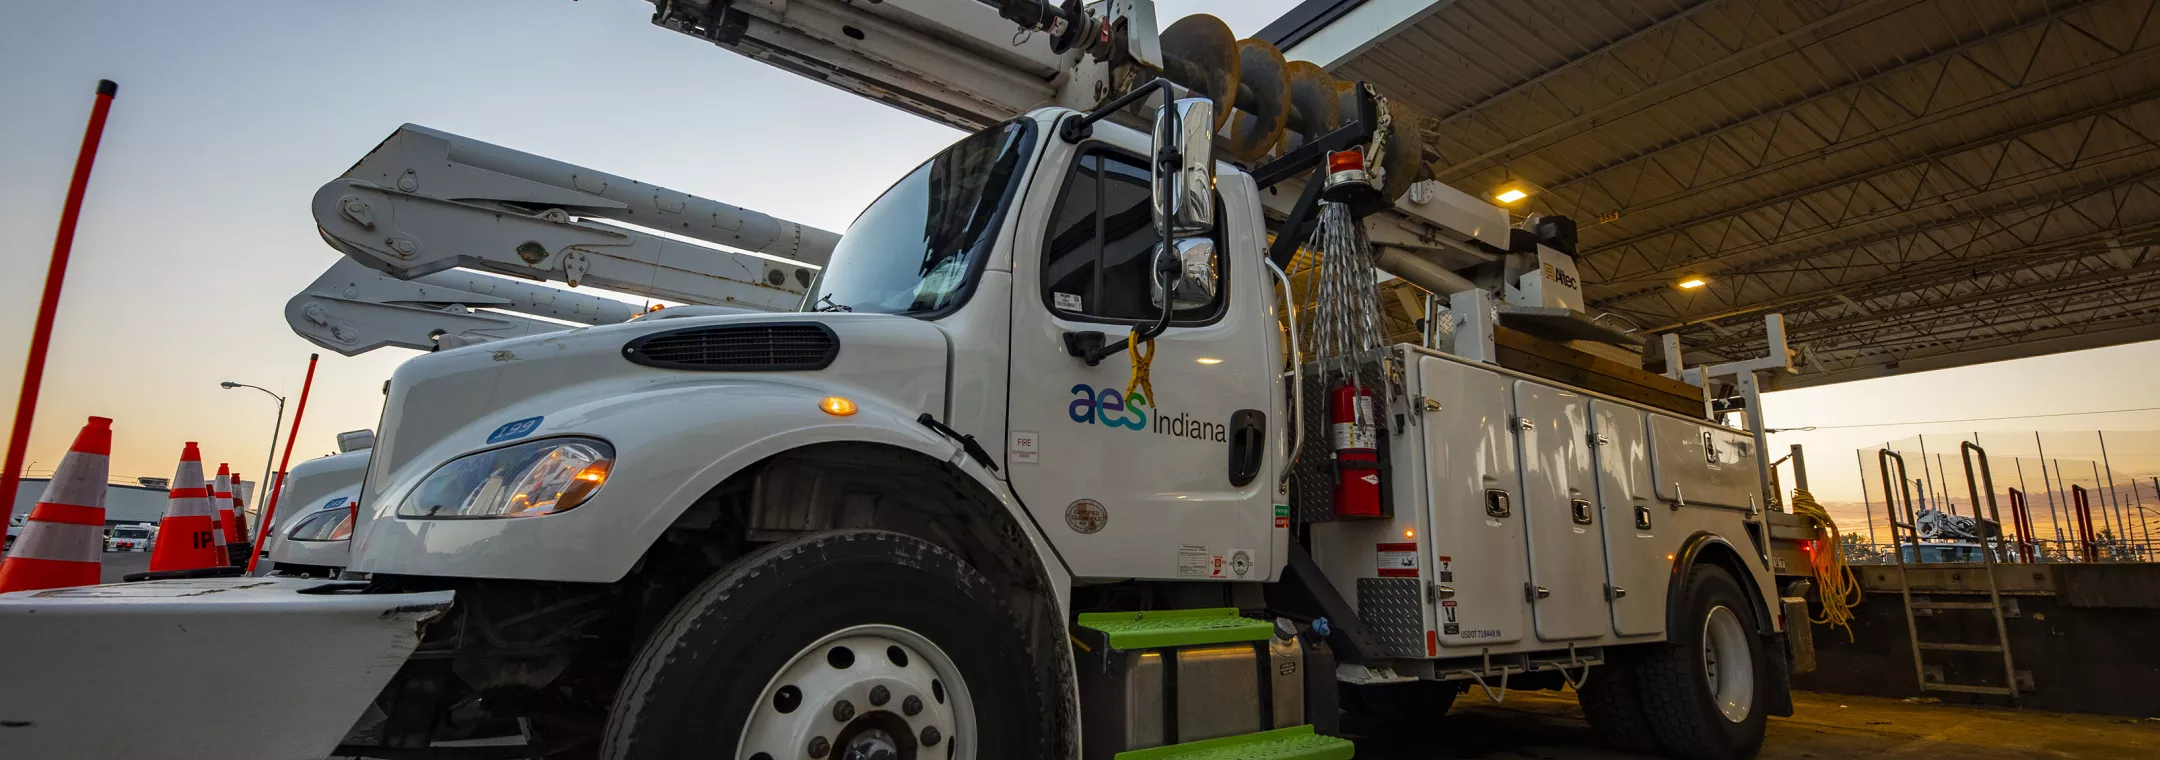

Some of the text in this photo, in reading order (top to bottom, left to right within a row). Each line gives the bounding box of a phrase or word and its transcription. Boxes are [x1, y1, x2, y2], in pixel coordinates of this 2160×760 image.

[1555, 267, 1577, 290] Altec
[1069, 384, 1227, 443] aes Indiana
[493, 420, 536, 439] 199
[1017, 438, 1031, 447] FIRE
[1460, 630, 1477, 639] USDOT
